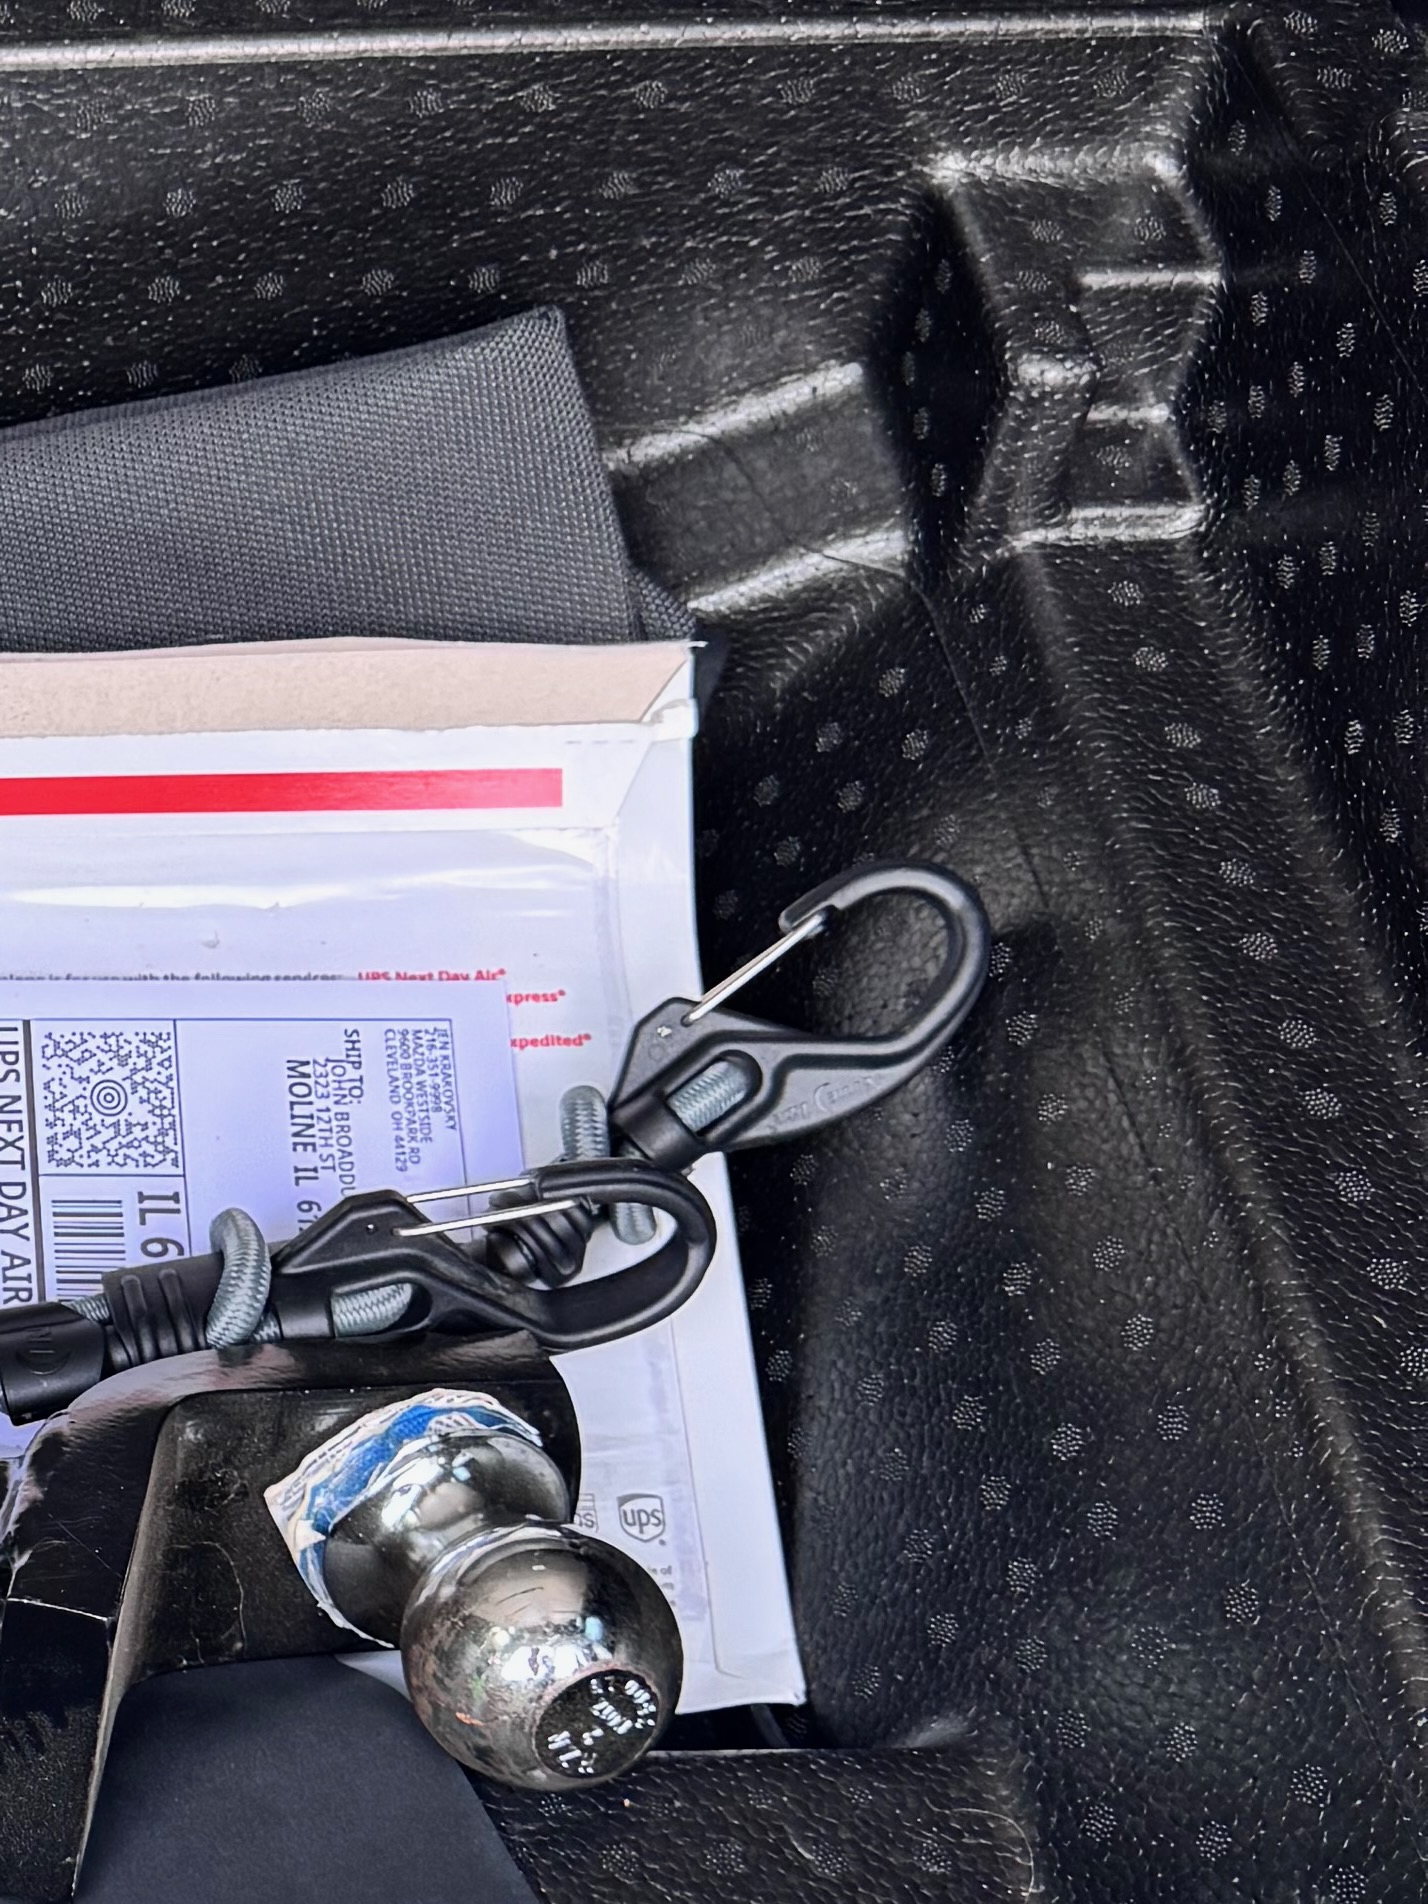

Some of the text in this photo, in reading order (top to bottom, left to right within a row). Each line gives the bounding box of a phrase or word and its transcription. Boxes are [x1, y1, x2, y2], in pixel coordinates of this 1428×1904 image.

[325, 1058, 348, 1106] JOHN
[344, 1028, 364, 1105] SHIP TO:
[384, 1028, 407, 1172] CLEVELAND OH 44129
[398, 1029, 421, 1165] 9600 BROOKPARK RD
[412, 1028, 432, 1144] MAZDA WESTSIDE
[424, 1028, 442, 1113] 216-351-9998
[441, 1054, 457, 1131] KRAKOVSKY
[285, 1059, 322, 1234] MOLINE IL 61
[312, 1058, 336, 1172] 2323 12TH ST
[136, 1190, 182, 1226] IL
[2, 1250, 33, 1306] AIR
[622, 1510, 662, 1535] ups
